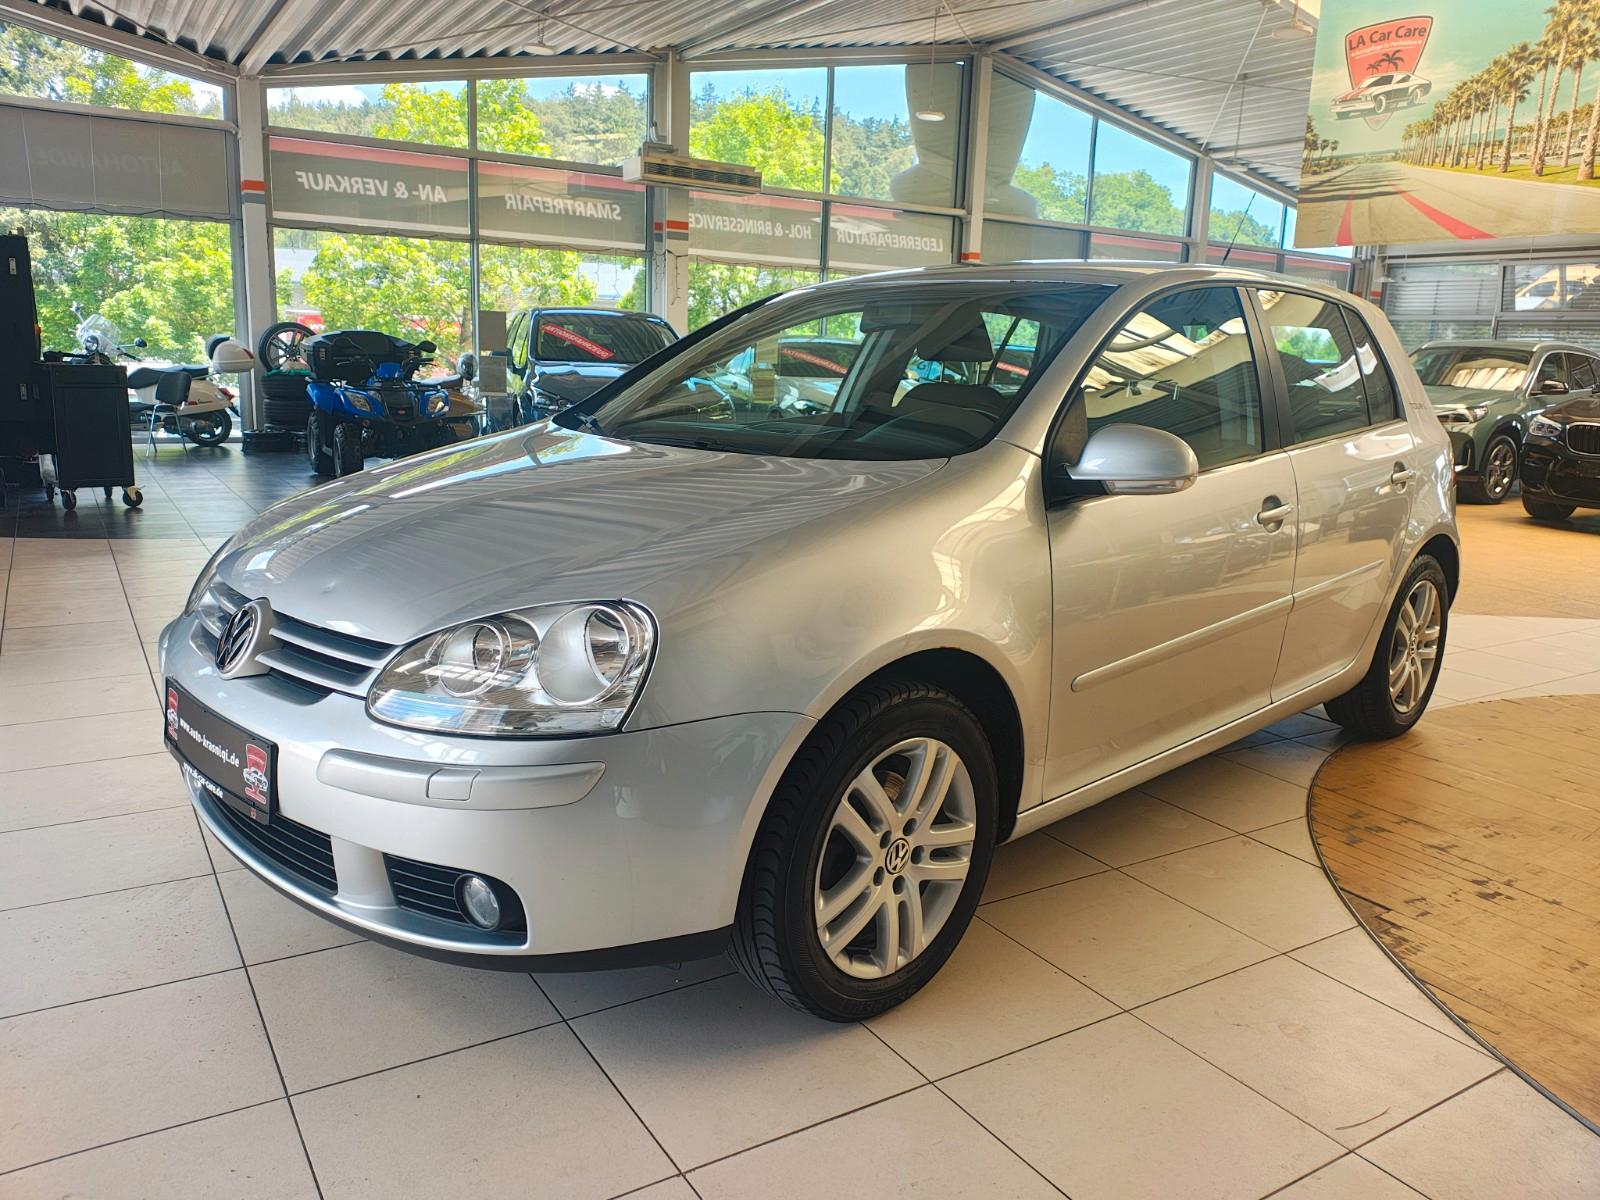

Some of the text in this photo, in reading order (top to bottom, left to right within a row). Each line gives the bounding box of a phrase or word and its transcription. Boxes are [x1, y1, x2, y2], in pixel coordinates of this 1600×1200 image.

[1349, 35, 1366, 51] LA
[1369, 30, 1393, 44] Car
[1395, 25, 1427, 39] Care
[179, 717, 240, 768] www.auto-krasniqi.de
